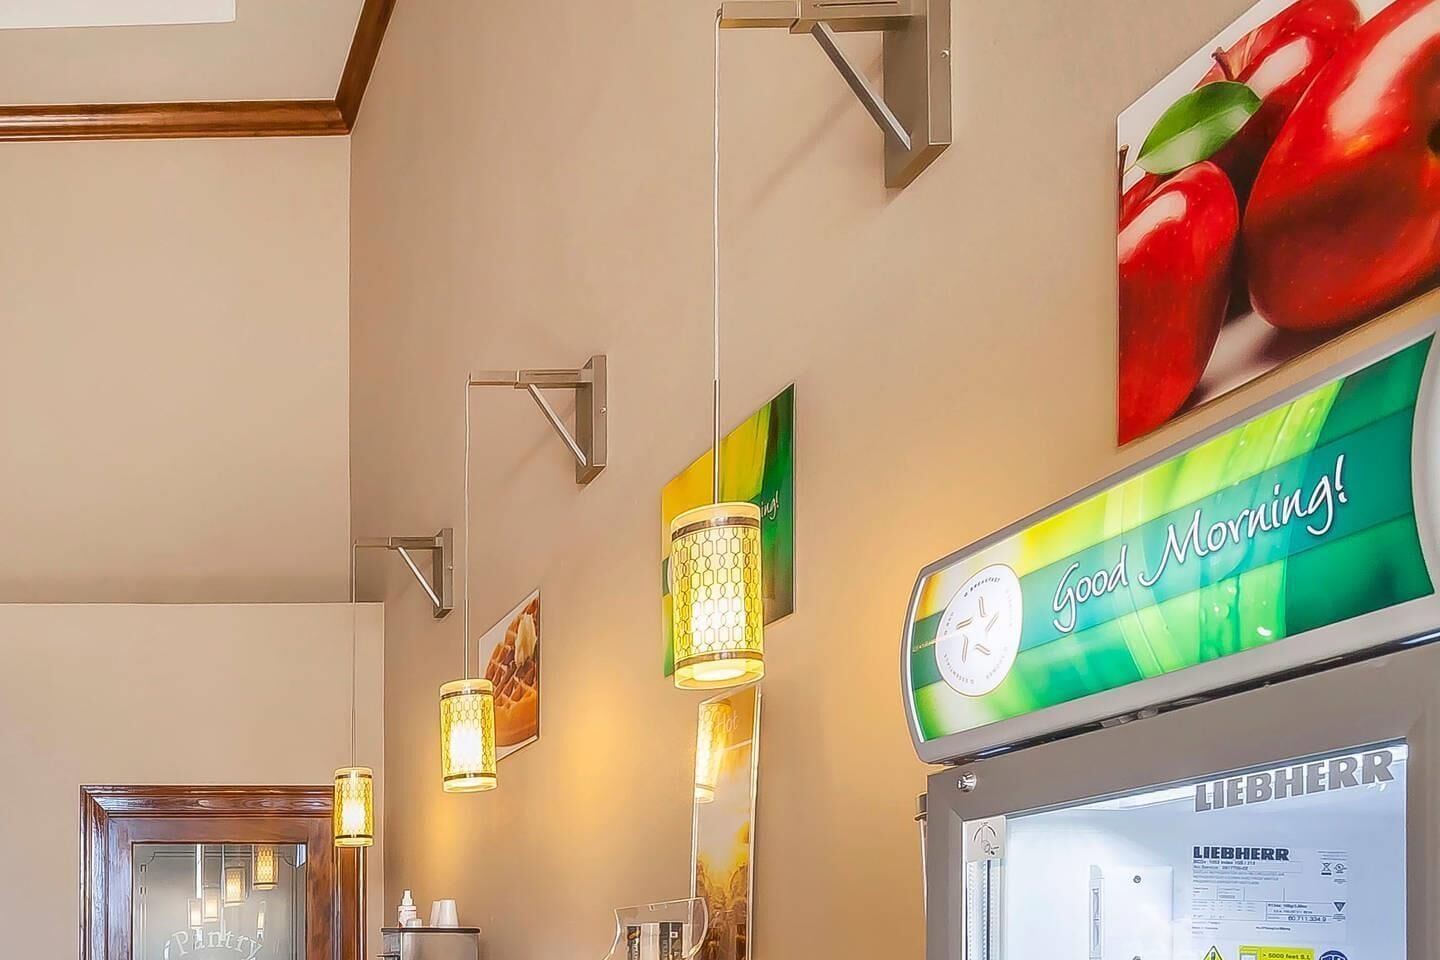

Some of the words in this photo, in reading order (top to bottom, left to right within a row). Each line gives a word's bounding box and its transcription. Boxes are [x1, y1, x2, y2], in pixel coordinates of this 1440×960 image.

[1052, 544, 1129, 634] Good
[1138, 453, 1349, 586] Morning!
[1194, 750, 1395, 812] LIEBHERR
[1192, 846, 1290, 861] LIEBHERR
